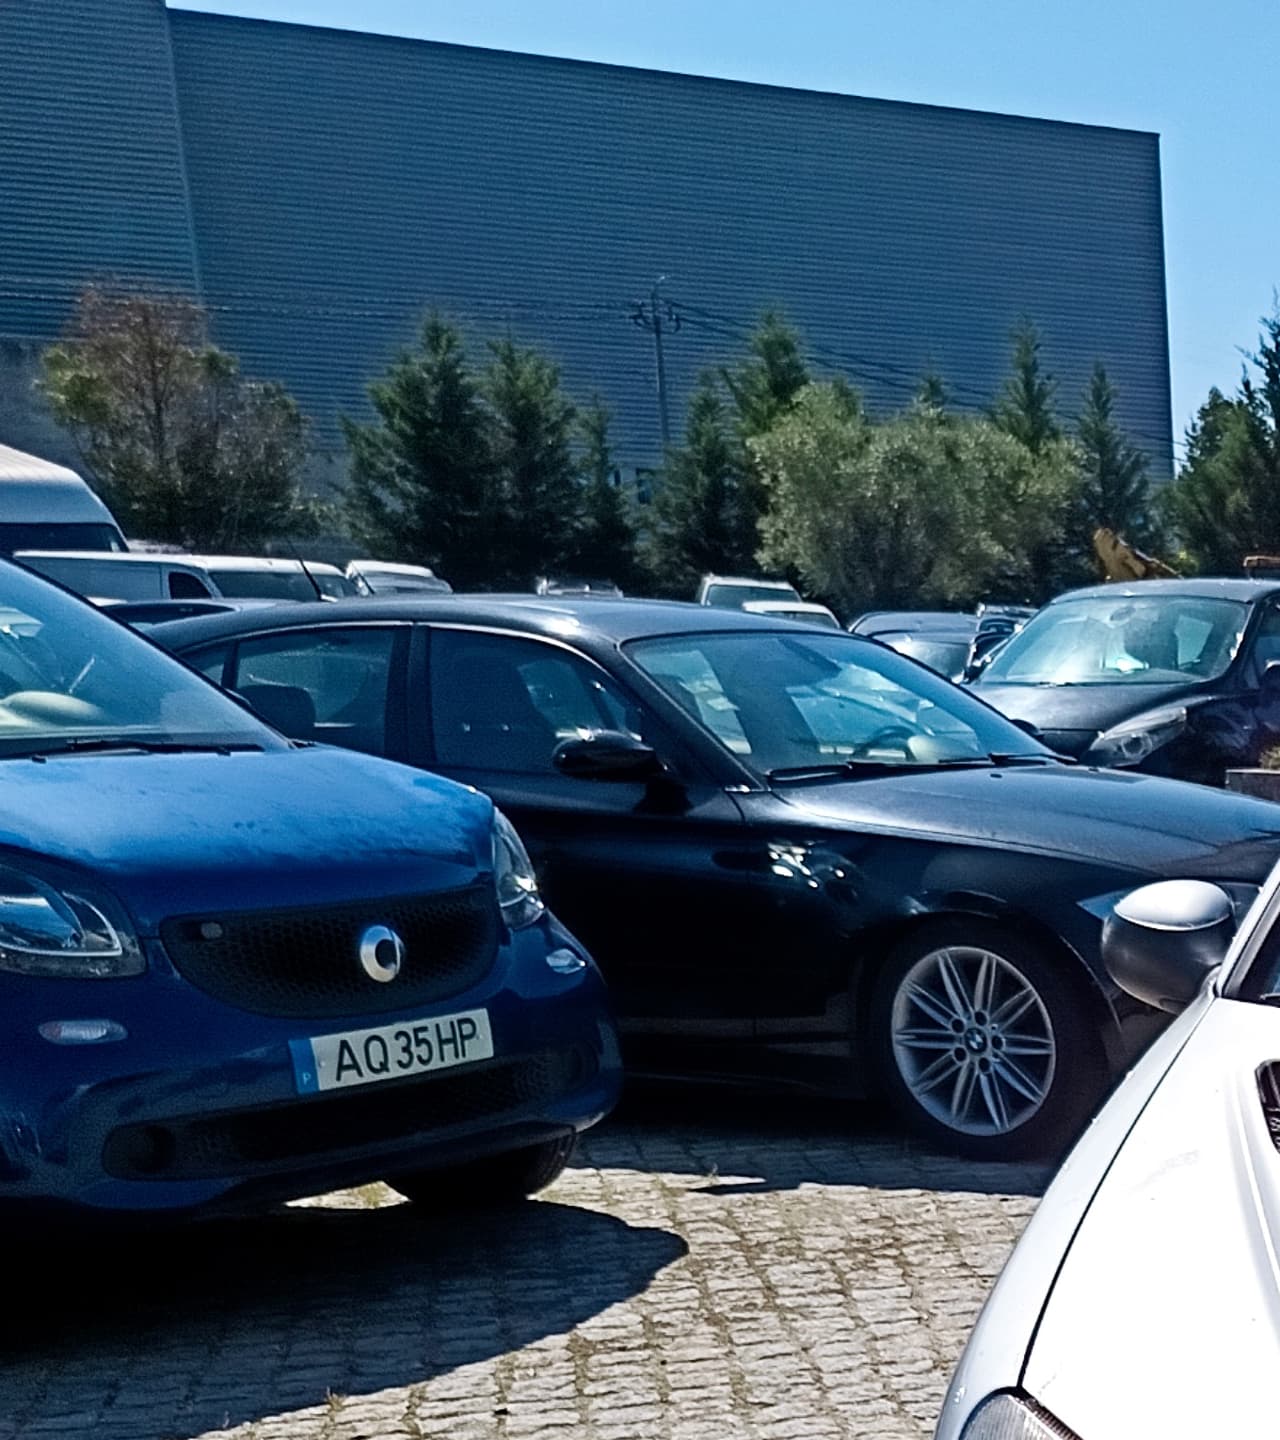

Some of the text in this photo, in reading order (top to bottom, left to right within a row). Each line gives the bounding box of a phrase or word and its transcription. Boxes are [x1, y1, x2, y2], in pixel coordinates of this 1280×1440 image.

[336, 1018, 477, 1082] AQ 35 HP
[302, 1072, 311, 1085] P
